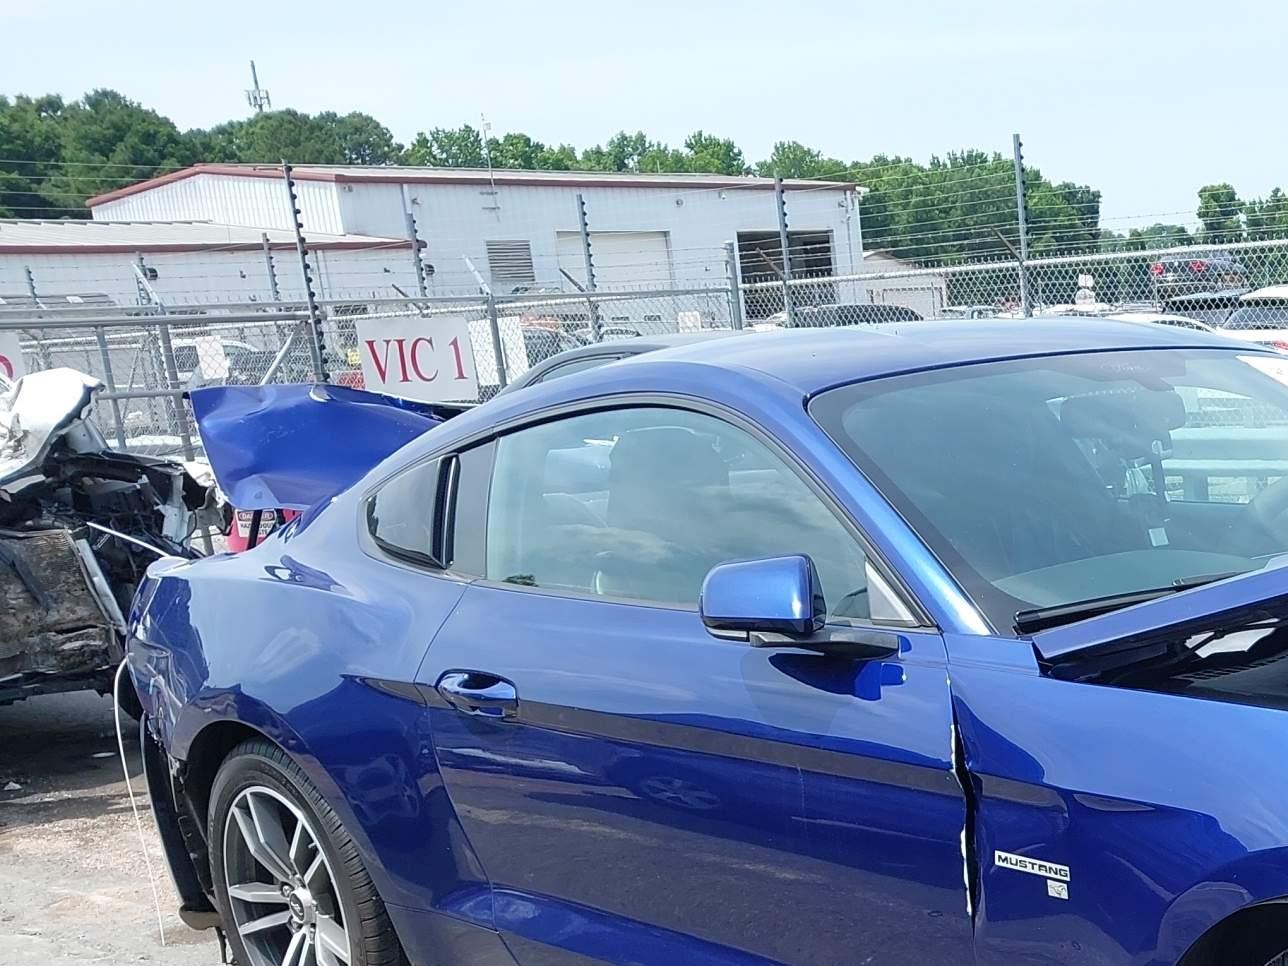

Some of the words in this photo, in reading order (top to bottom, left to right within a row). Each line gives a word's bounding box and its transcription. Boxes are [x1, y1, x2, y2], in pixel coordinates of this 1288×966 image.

[364, 336, 440, 385] VIC
[447, 335, 469, 381] 1
[997, 854, 1069, 878] MUSTANG
